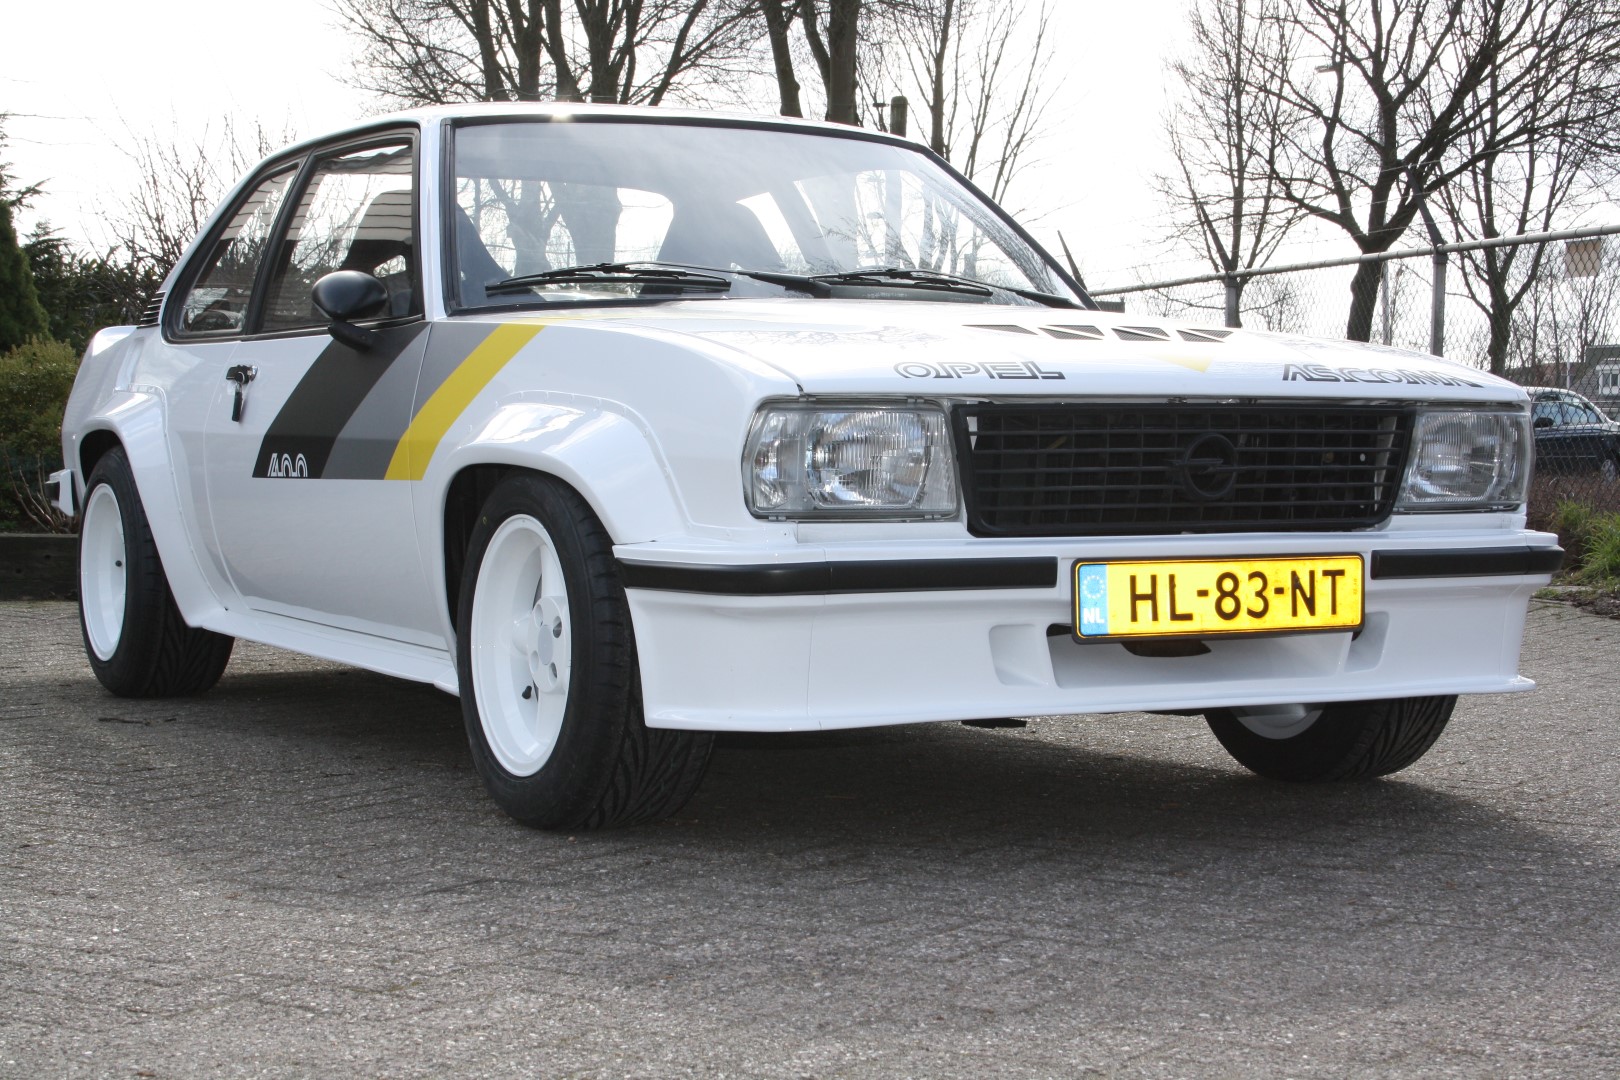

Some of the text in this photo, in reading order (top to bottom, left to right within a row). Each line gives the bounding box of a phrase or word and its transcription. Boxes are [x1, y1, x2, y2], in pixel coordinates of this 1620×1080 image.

[893, 361, 1066, 380] OPEL
[1282, 363, 1485, 388] ASCONA
[1129, 569, 1346, 623] HL-83-NT
[1083, 607, 1105, 624] NL
